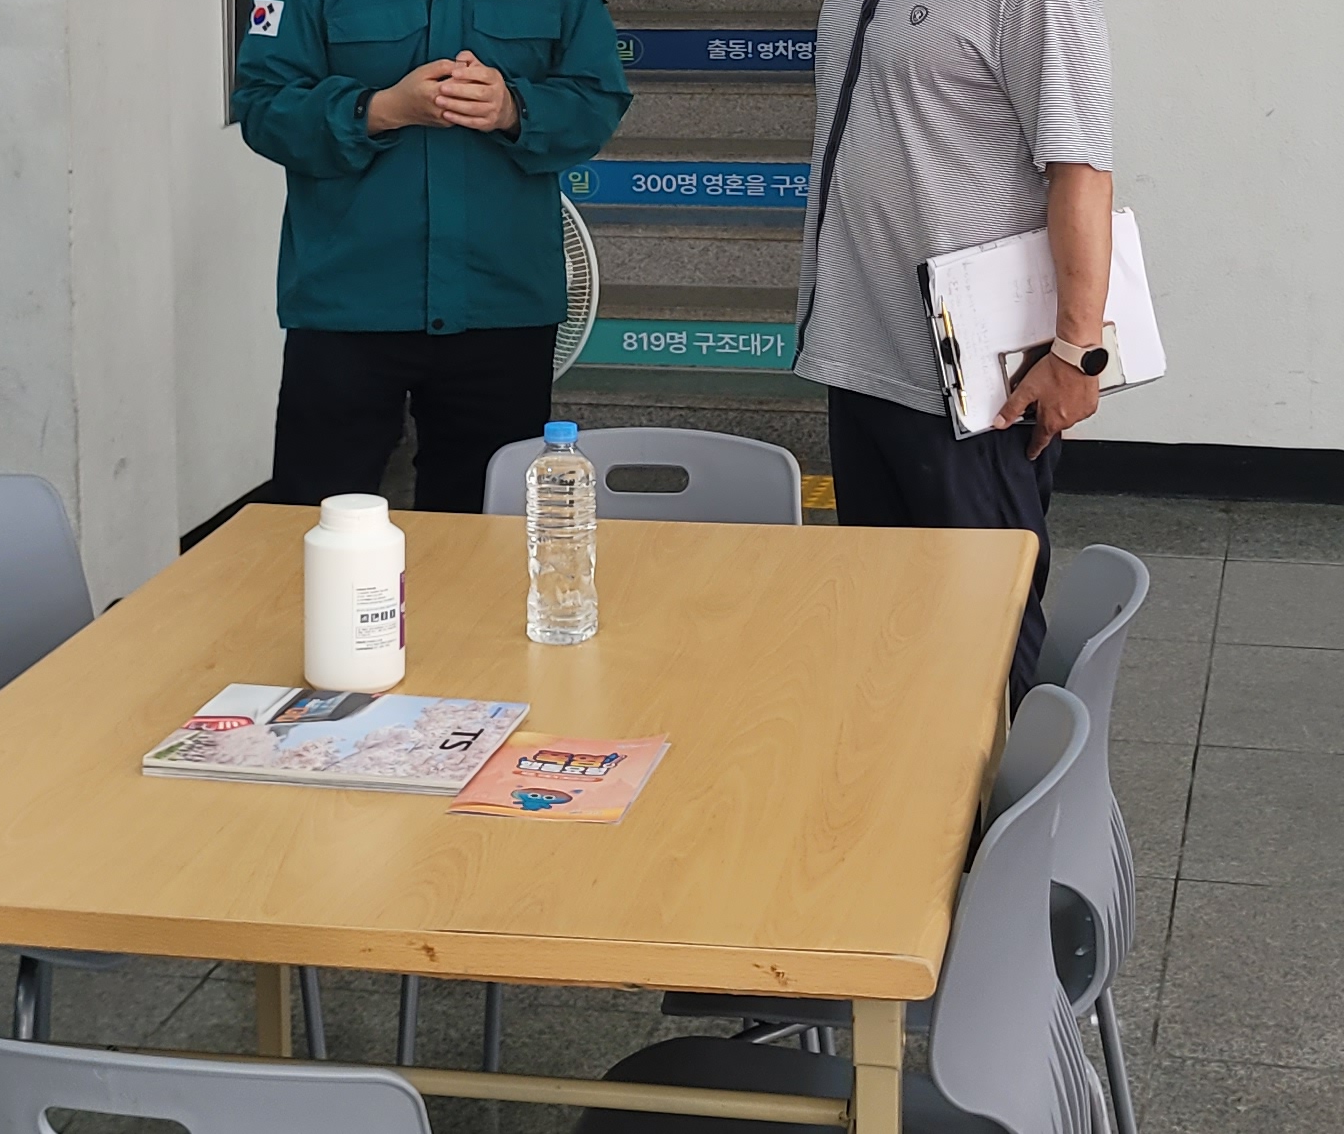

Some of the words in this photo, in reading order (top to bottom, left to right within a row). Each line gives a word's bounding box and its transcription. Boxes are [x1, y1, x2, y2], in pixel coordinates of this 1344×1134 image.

[707, 39, 753, 60] 출동!
[757, 39, 817, 60] 영차영
[568, 171, 590, 194] 일
[632, 173, 697, 195] 300명
[702, 173, 767, 197] 영혼을
[622, 331, 687, 354] 819명
[692, 333, 785, 357] 구조대가
